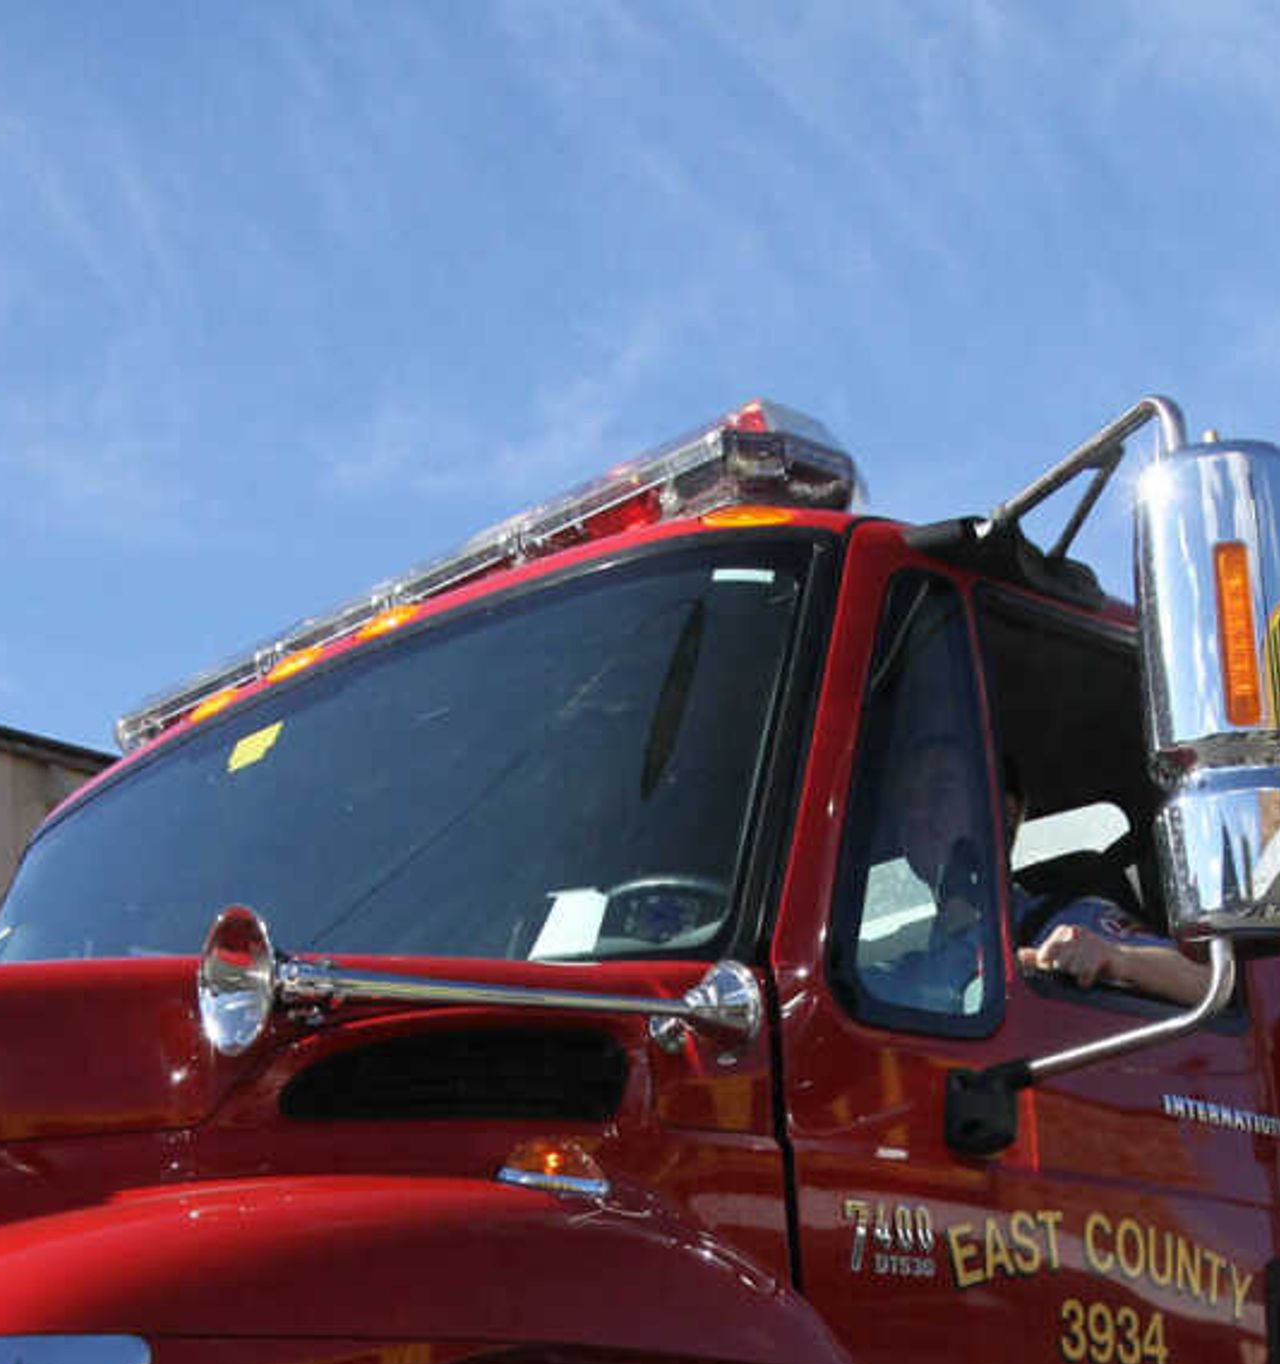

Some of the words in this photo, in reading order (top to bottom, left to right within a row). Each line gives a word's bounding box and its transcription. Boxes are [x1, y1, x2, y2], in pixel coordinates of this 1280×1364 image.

[845, 1200, 934, 1271] 7400
[949, 1210, 1063, 1286] EAST
[1084, 1213, 1253, 1318] COUNTY
